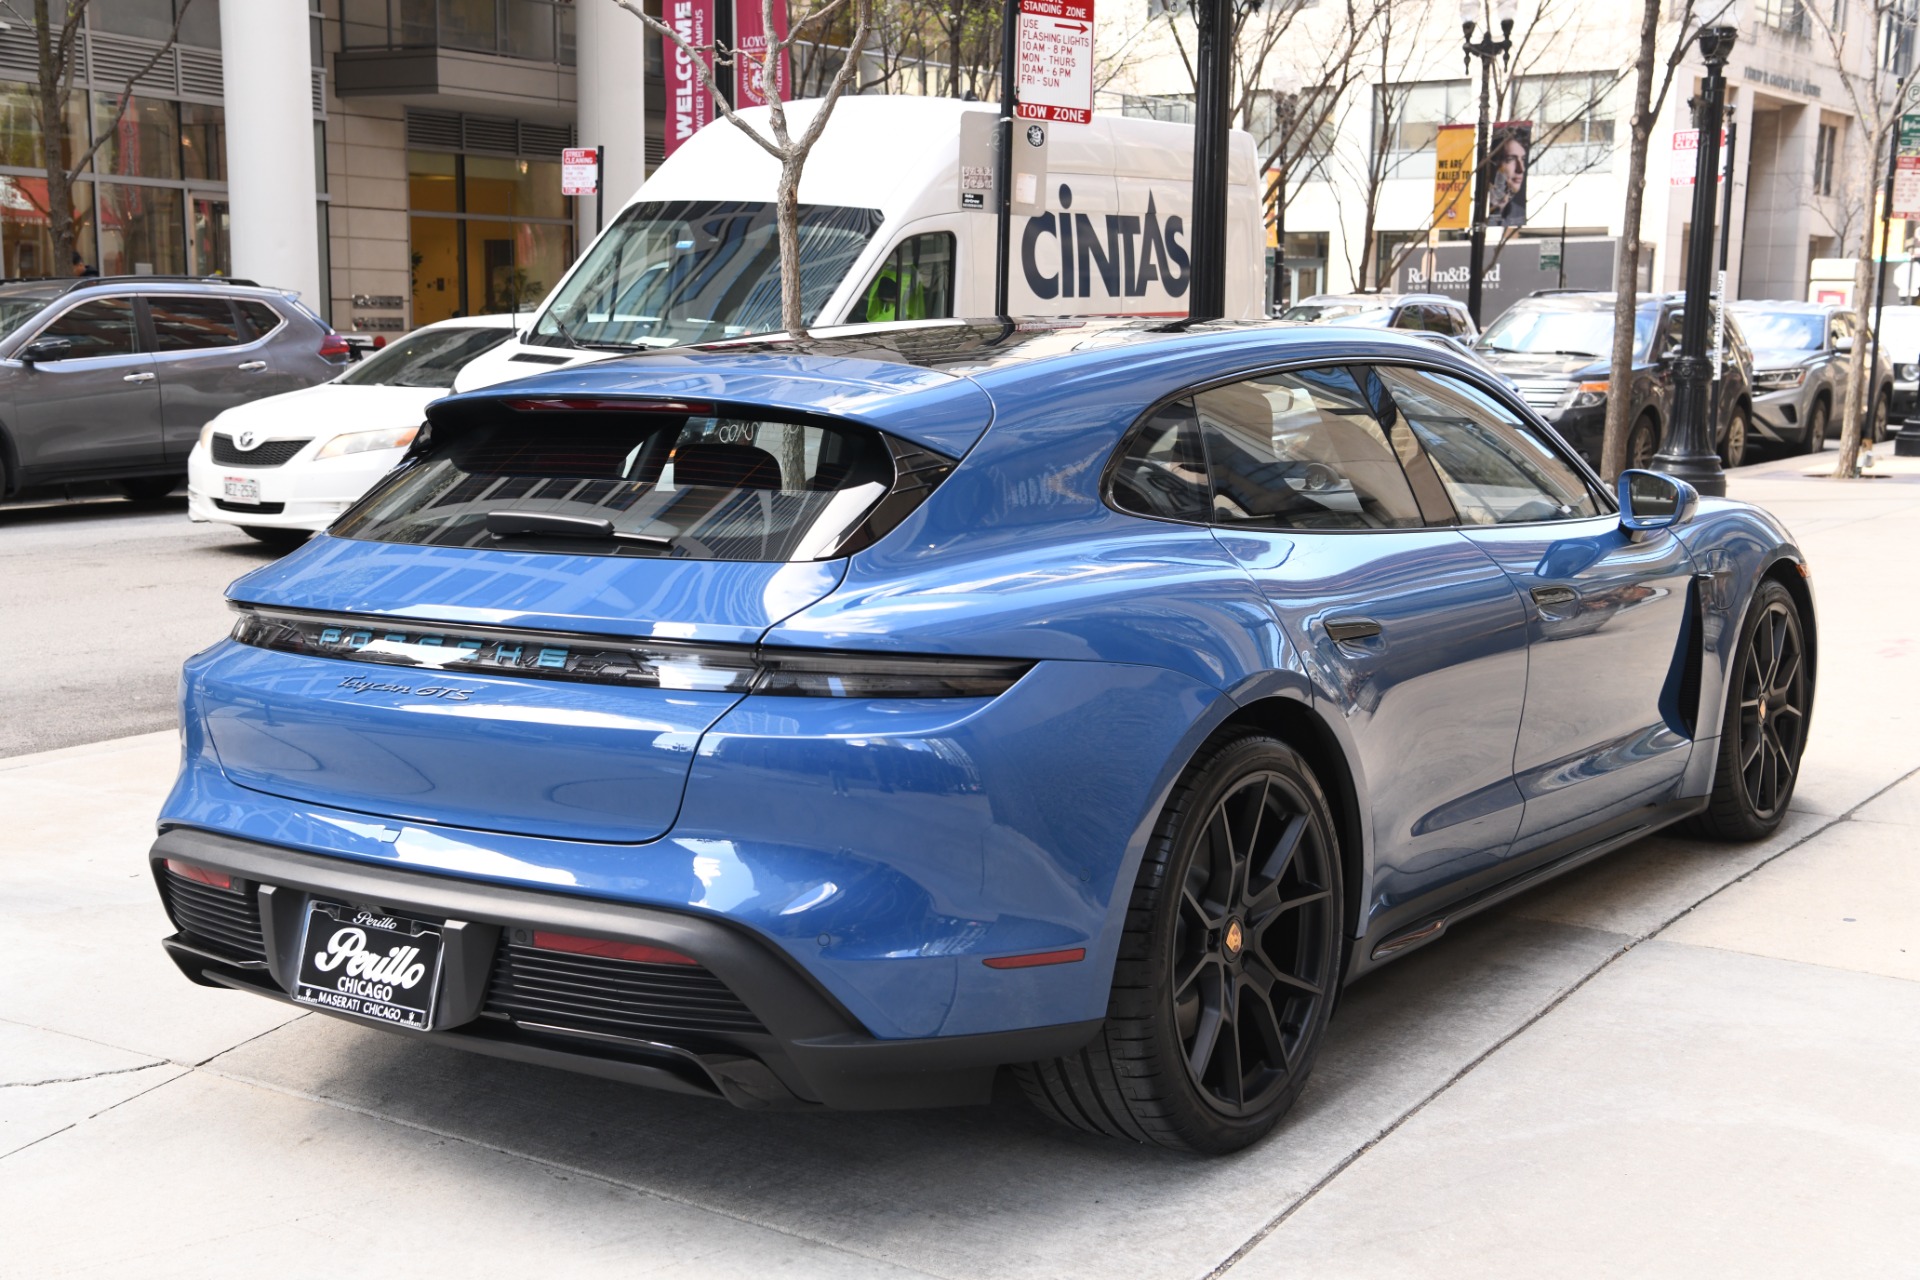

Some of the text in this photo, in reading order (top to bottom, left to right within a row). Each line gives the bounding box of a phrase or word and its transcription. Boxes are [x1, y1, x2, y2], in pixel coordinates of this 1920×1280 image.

[1024, 1, 1086, 19] STANDING ZONE
[1023, 18, 1039, 29] USE
[742, 36, 767, 48] LOYO
[1022, 30, 1090, 47] FLASHING LIGHTS
[1060, 46, 1073, 56] PM
[1022, 53, 1040, 63] MON
[1049, 55, 1076, 68] THURS
[675, 1, 692, 140] WELCOME
[1059, 68, 1071, 78] PM
[1021, 75, 1035, 85] FRI
[1043, 77, 1060, 88] SUN
[695, 96, 704, 131] WATER
[1021, 104, 1086, 123] TOW ZONE
[565, 157, 594, 165] CLEANING
[1438, 160, 1462, 169] WE ARE
[1437, 171, 1460, 180] CALLED
[1408, 263, 1500, 283] Rom&Brd
[337, 675, 475, 701] Taycan GTS
[352, 911, 398, 930] Perillo
[314, 927, 426, 990] Perillo
[337, 976, 393, 1002] CHICAGO
[318, 991, 360, 1012] MASERATI
[363, 1002, 401, 1020] CHICAGO
